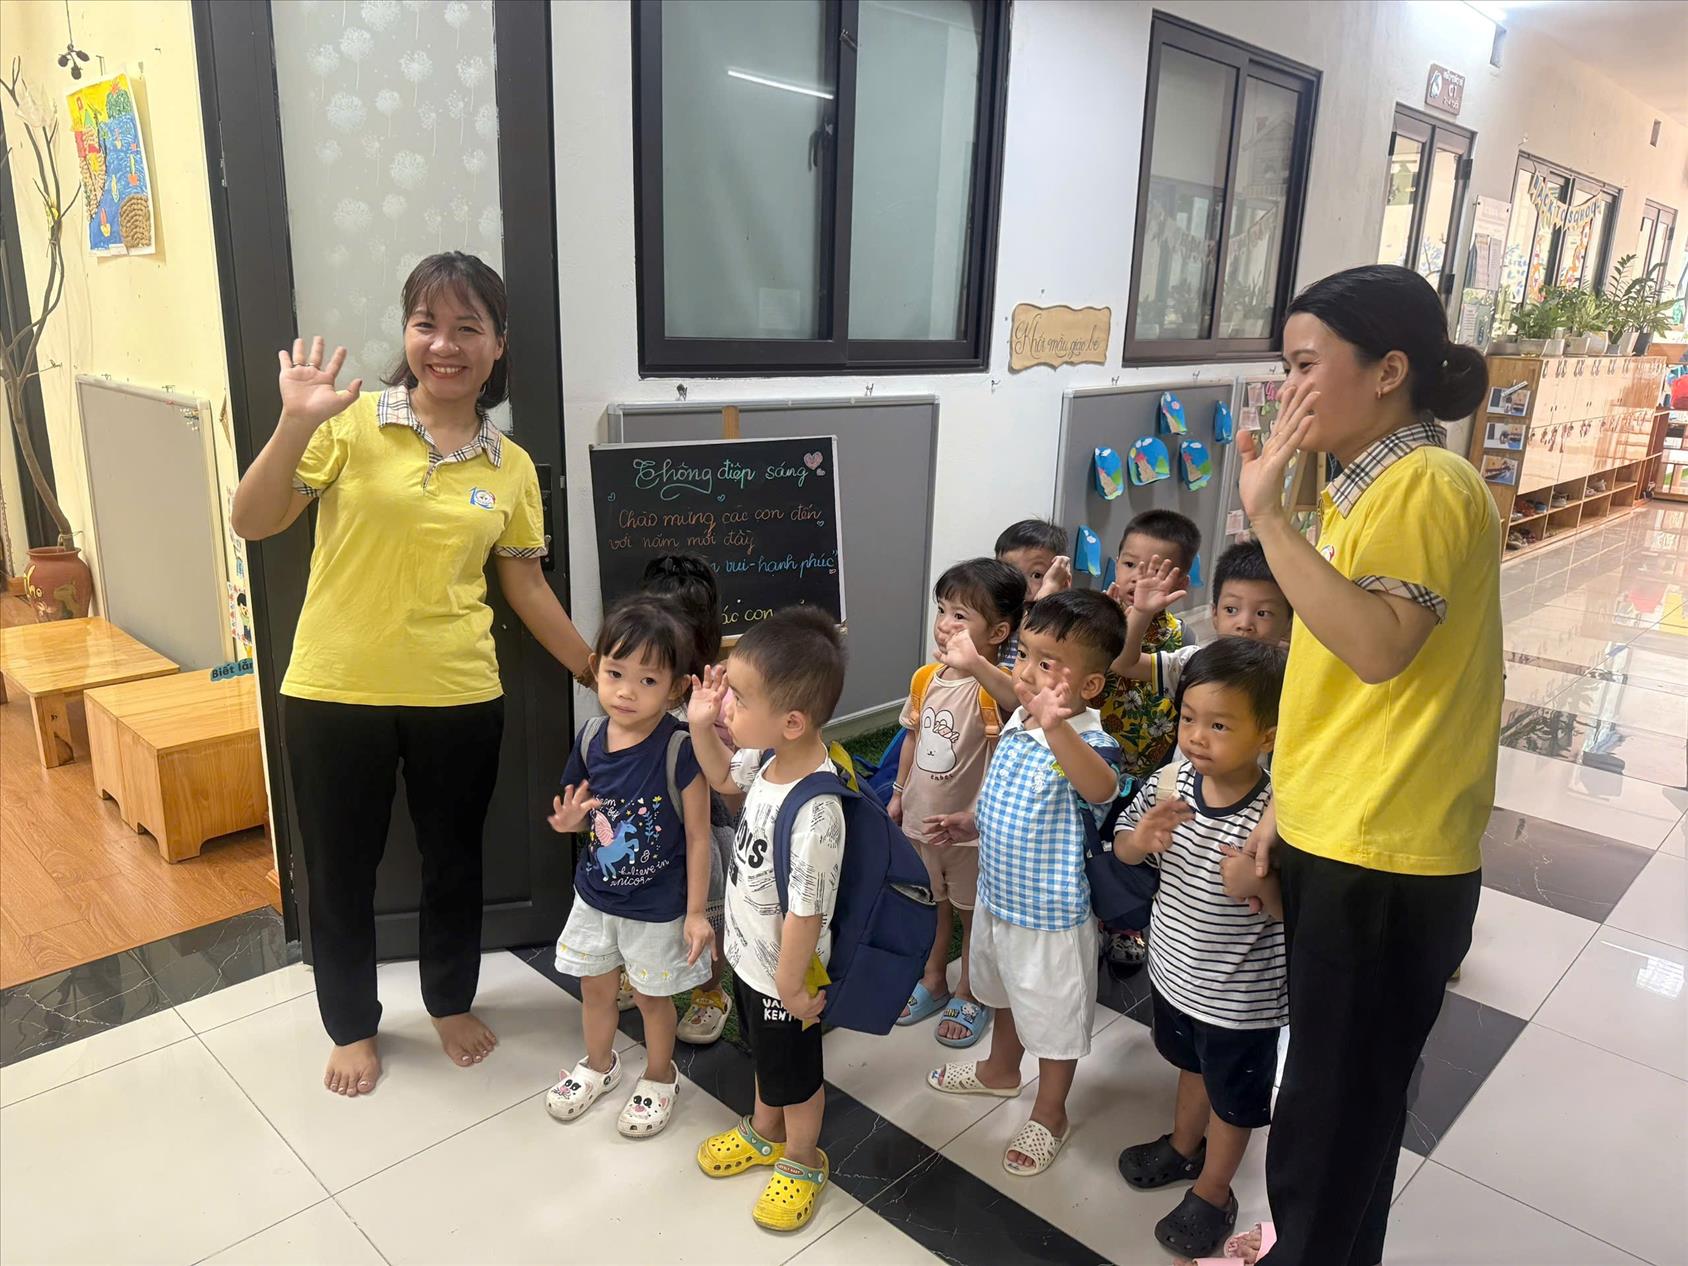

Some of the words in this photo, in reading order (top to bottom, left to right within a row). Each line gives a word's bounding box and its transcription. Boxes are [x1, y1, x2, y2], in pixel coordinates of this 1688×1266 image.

[633, 458, 712, 501] Thông
[717, 458, 756, 489] điệp
[765, 461, 809, 488] sáng
[754, 508, 784, 521] con
[212, 663, 236, 679] Biết
